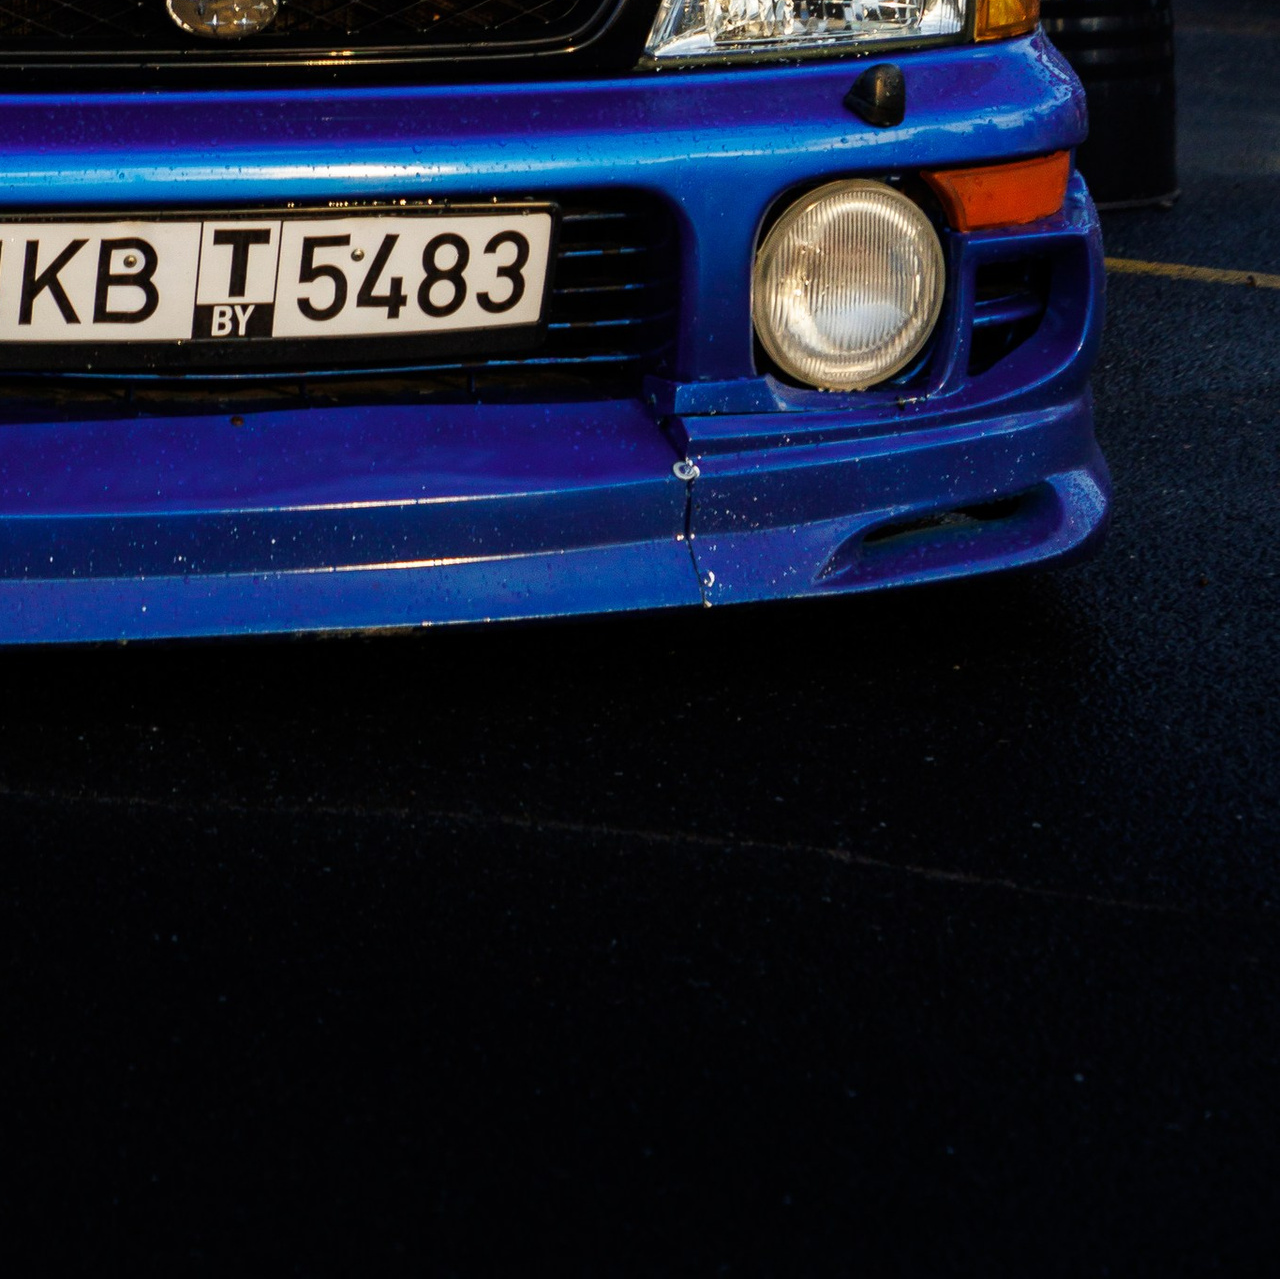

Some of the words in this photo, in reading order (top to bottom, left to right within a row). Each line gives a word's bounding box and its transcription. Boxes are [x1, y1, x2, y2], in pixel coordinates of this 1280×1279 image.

[213, 228, 271, 297] T
[297, 229, 531, 321] 5483
[211, 304, 255, 337] BY
